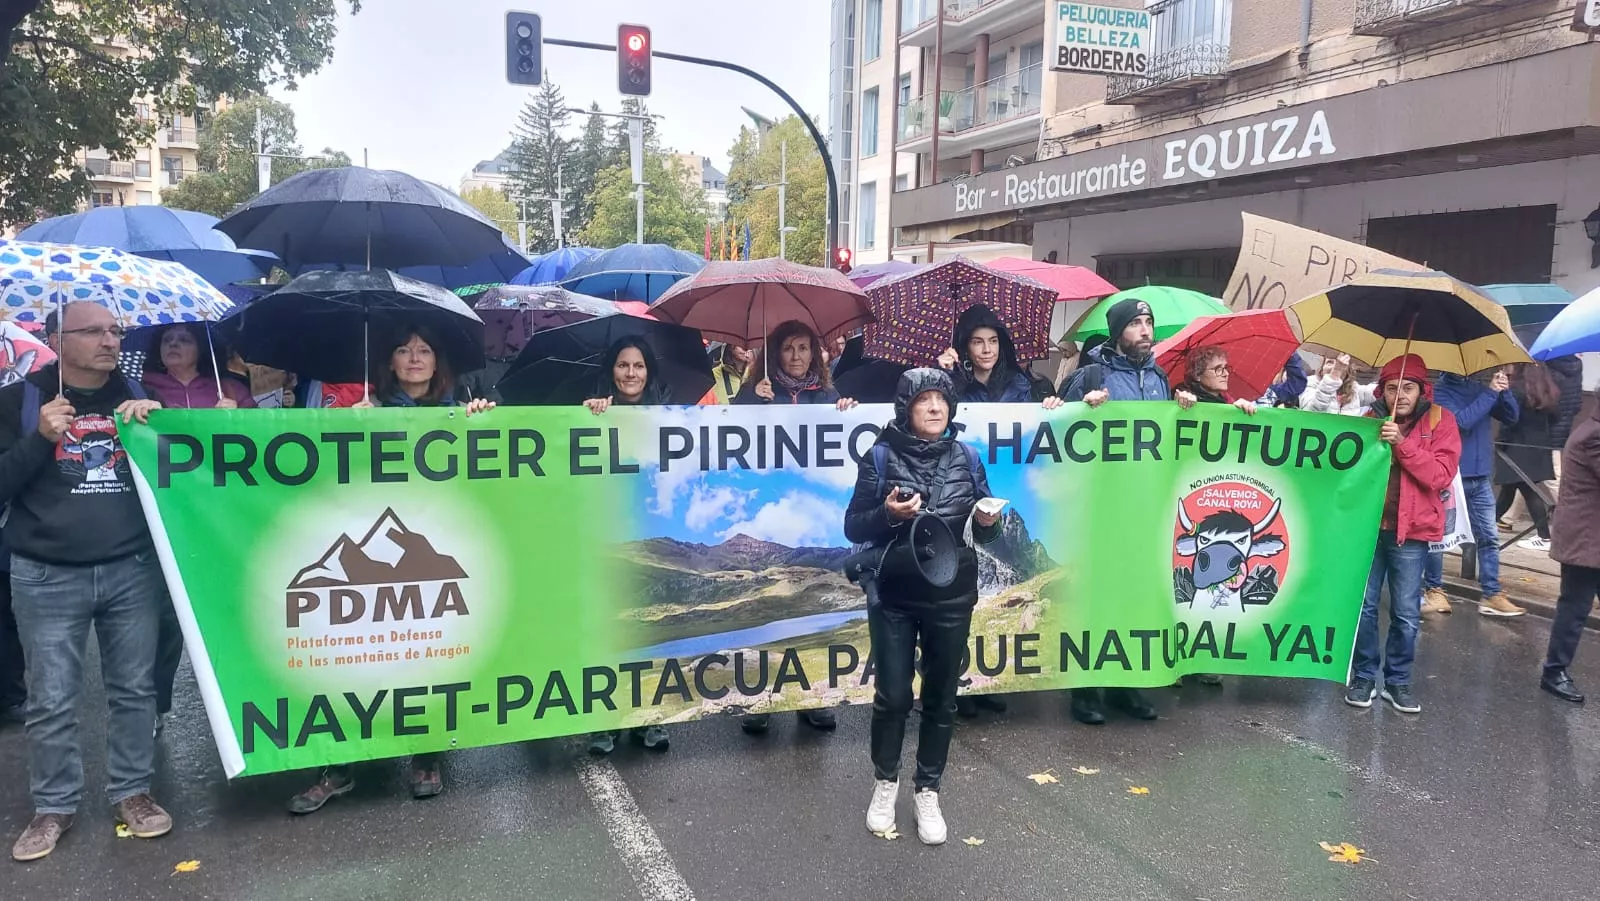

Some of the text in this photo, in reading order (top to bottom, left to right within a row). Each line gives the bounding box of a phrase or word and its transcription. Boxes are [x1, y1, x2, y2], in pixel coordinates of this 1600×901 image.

[1059, 4, 1148, 29] PELUQUERIA
[1065, 26, 1140, 48] BELLEZA
[1058, 45, 1147, 72] BORDERAS
[955, 182, 986, 212] Bar
[1004, 153, 1146, 206] Restaurante
[1162, 109, 1336, 180] EQUIZA
[1251, 228, 1285, 267] EL
[1229, 272, 1287, 310] NO
[157, 419, 1364, 489] PROTEGER EL PIRINEO HACER FUTURO
[1189, 479, 1202, 490] NO
[1203, 488, 1258, 499] ¡SALVEMOS
[1196, 497, 1262, 509] CANAL ROYA!
[286, 582, 470, 628] PDMA
[287, 629, 443, 649] Plataforma en Defensa
[1060, 621, 1248, 673] NATURAL
[1262, 623, 1335, 665] YA!
[288, 643, 470, 669] de las montañas de Aragón
